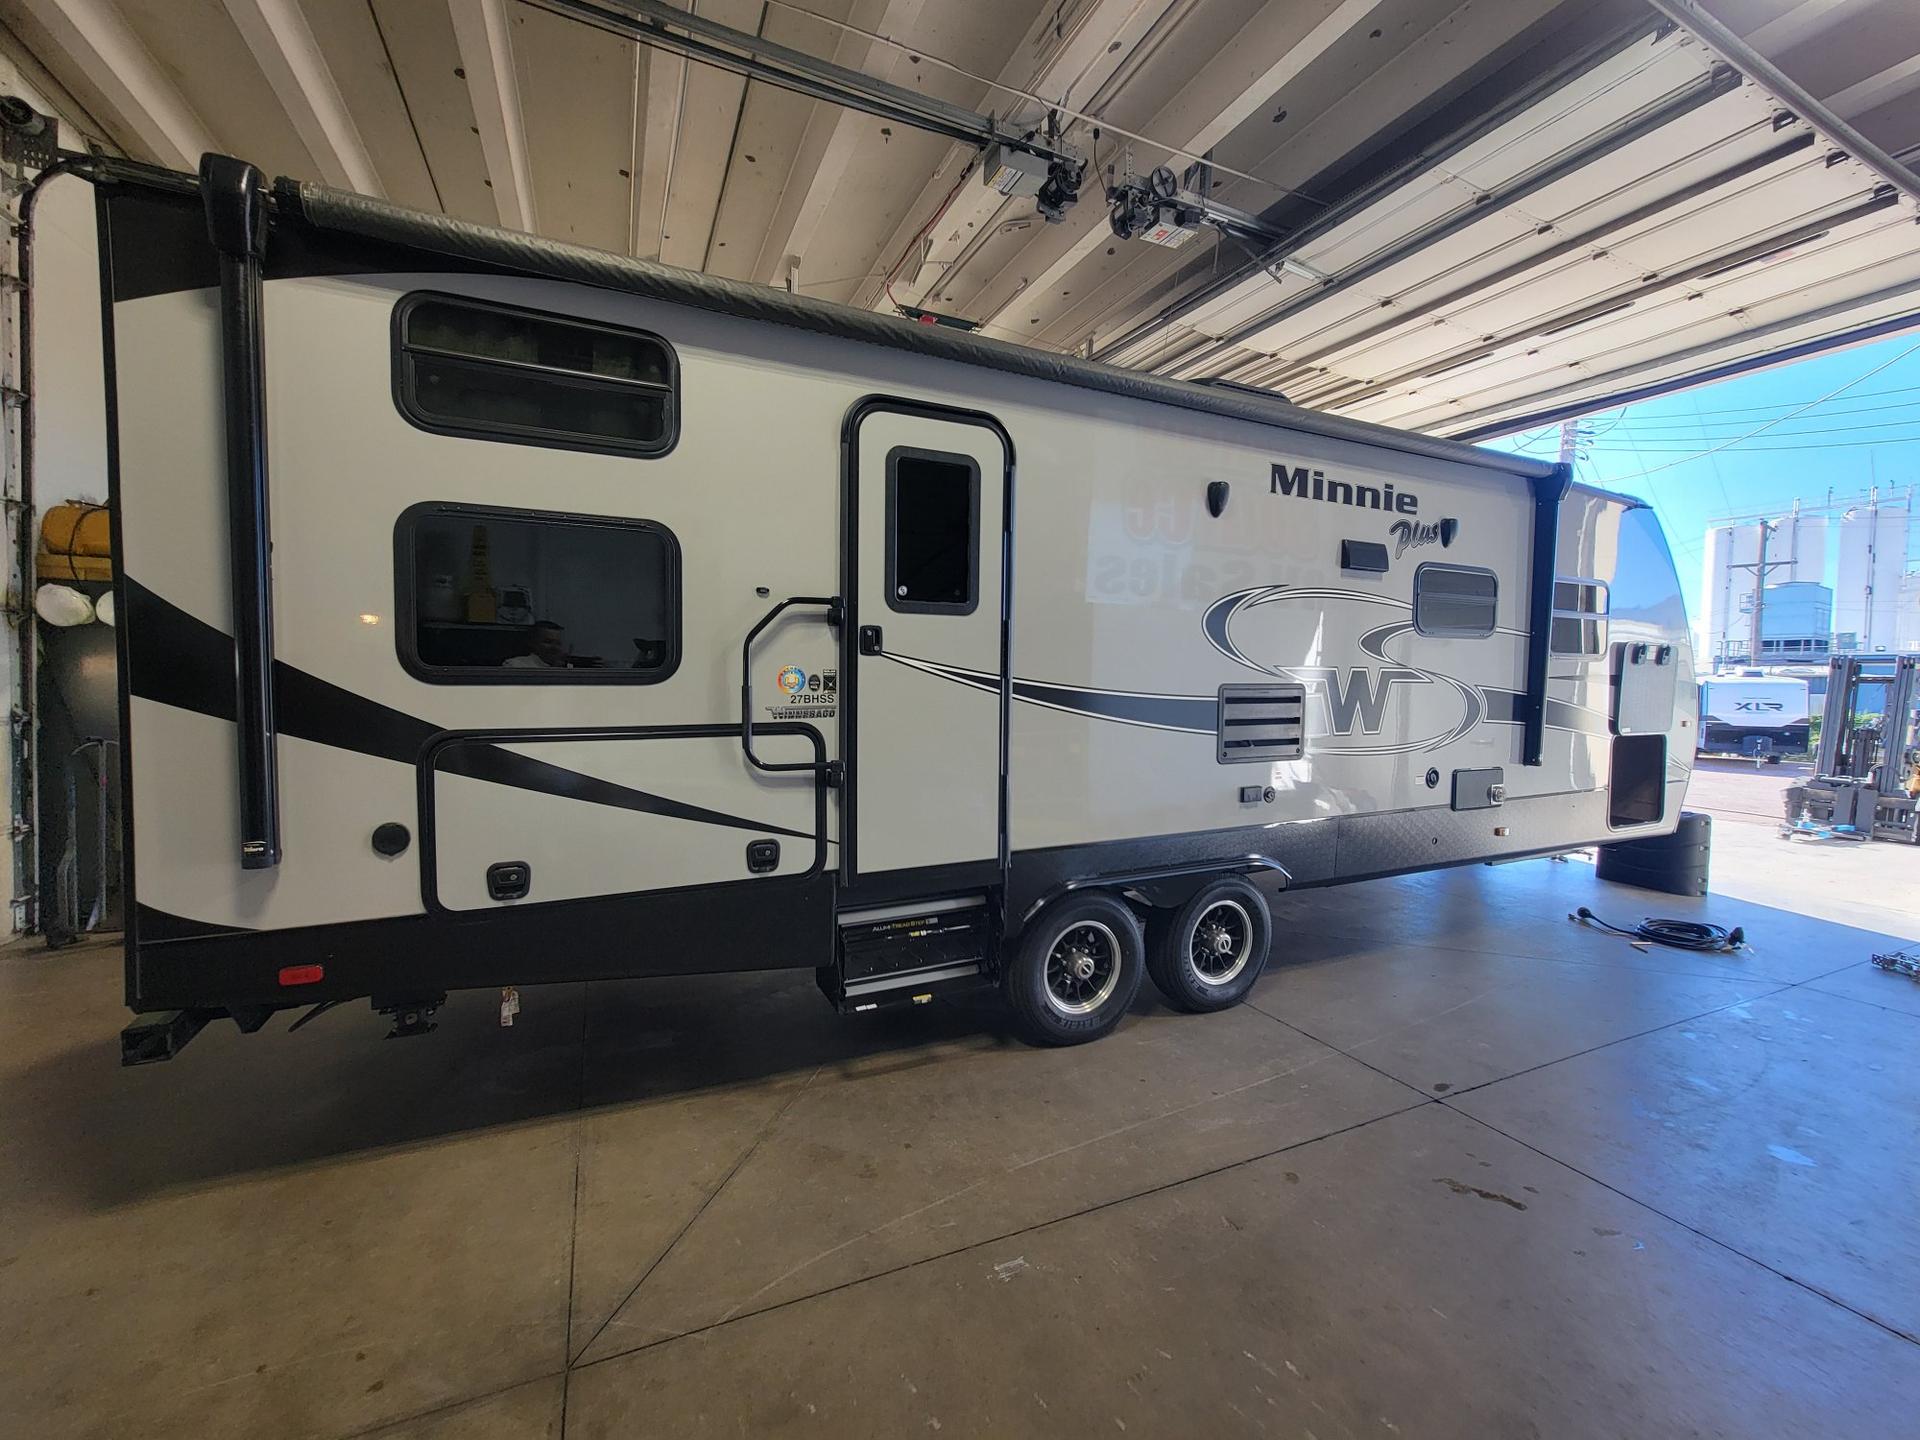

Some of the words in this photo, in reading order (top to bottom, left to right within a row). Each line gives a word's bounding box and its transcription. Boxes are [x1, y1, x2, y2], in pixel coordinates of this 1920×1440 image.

[1270, 463, 1418, 515] Minnie
[1389, 518, 1439, 560] Plus
[790, 694, 835, 704] 27BHSS
[1735, 702, 1784, 712] XLR
